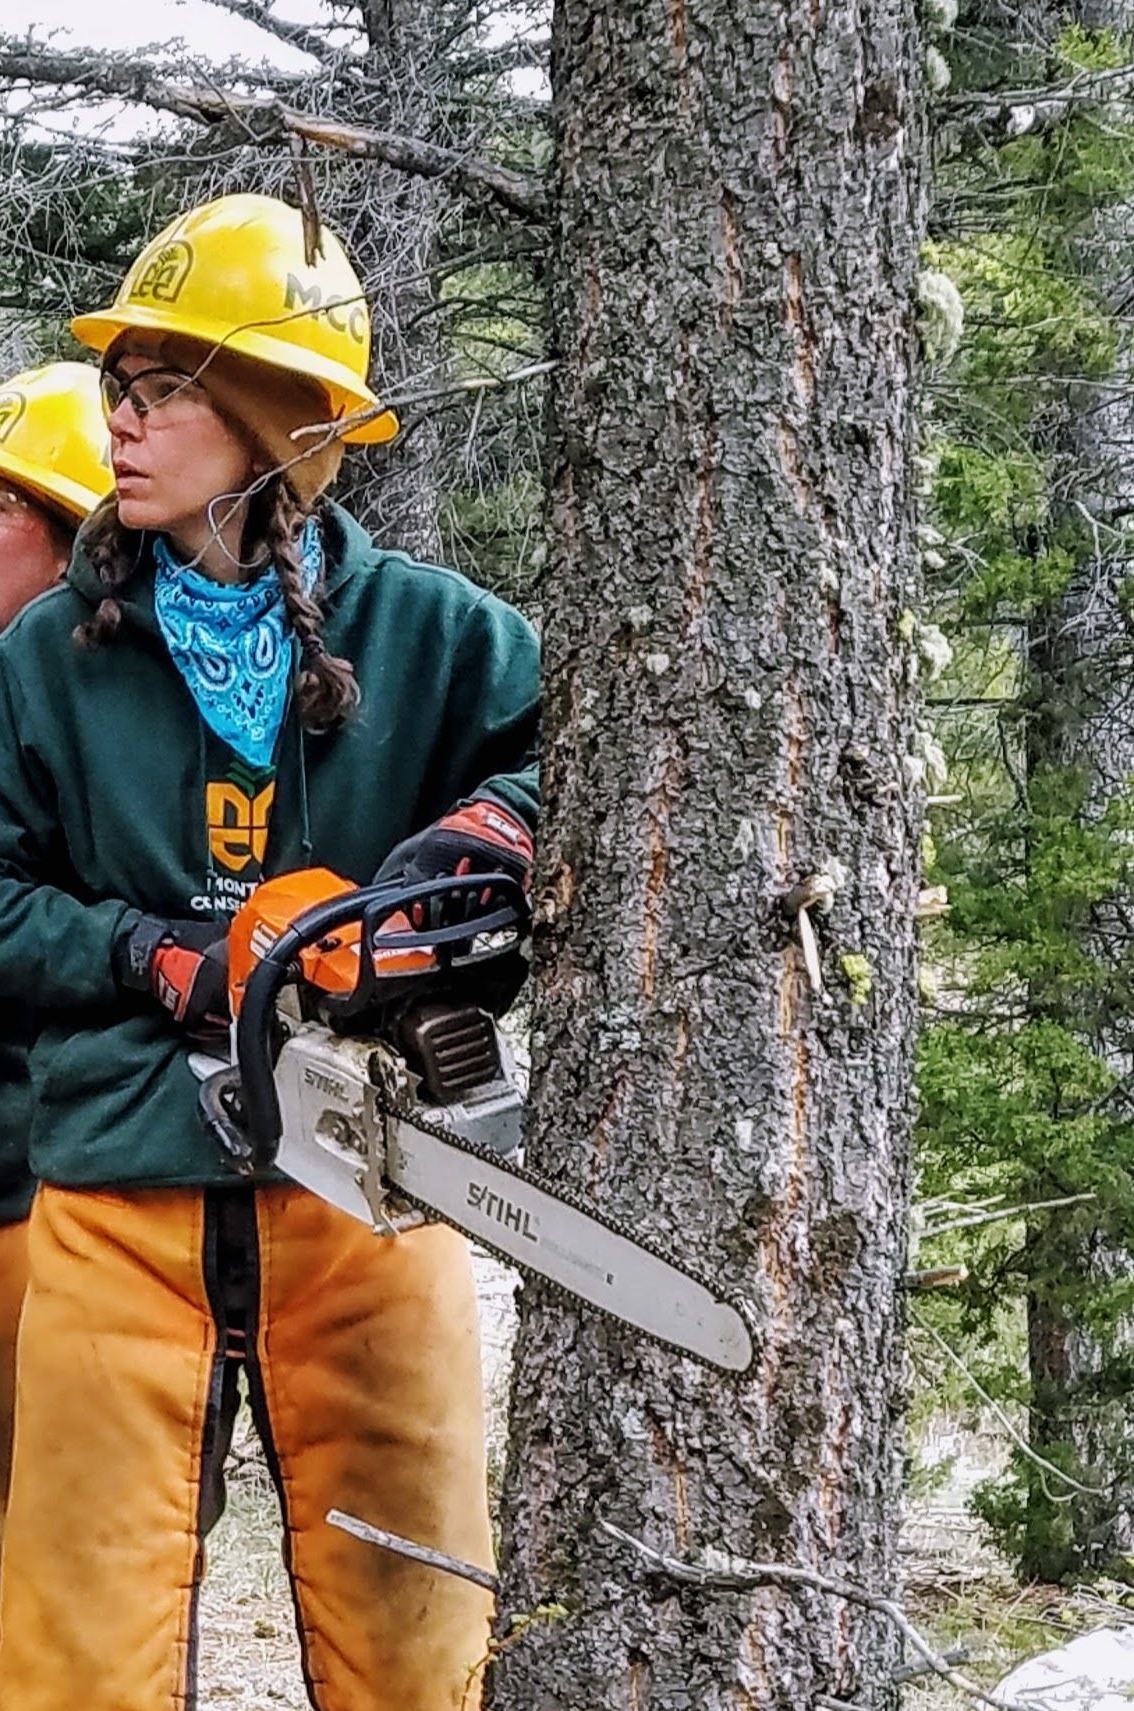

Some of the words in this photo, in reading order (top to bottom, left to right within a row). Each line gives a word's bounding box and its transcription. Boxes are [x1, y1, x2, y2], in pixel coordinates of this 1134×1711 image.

[206, 876, 262, 898] MONT
[304, 1068, 350, 1103] STIHL
[466, 1181, 539, 1243] STIHL
